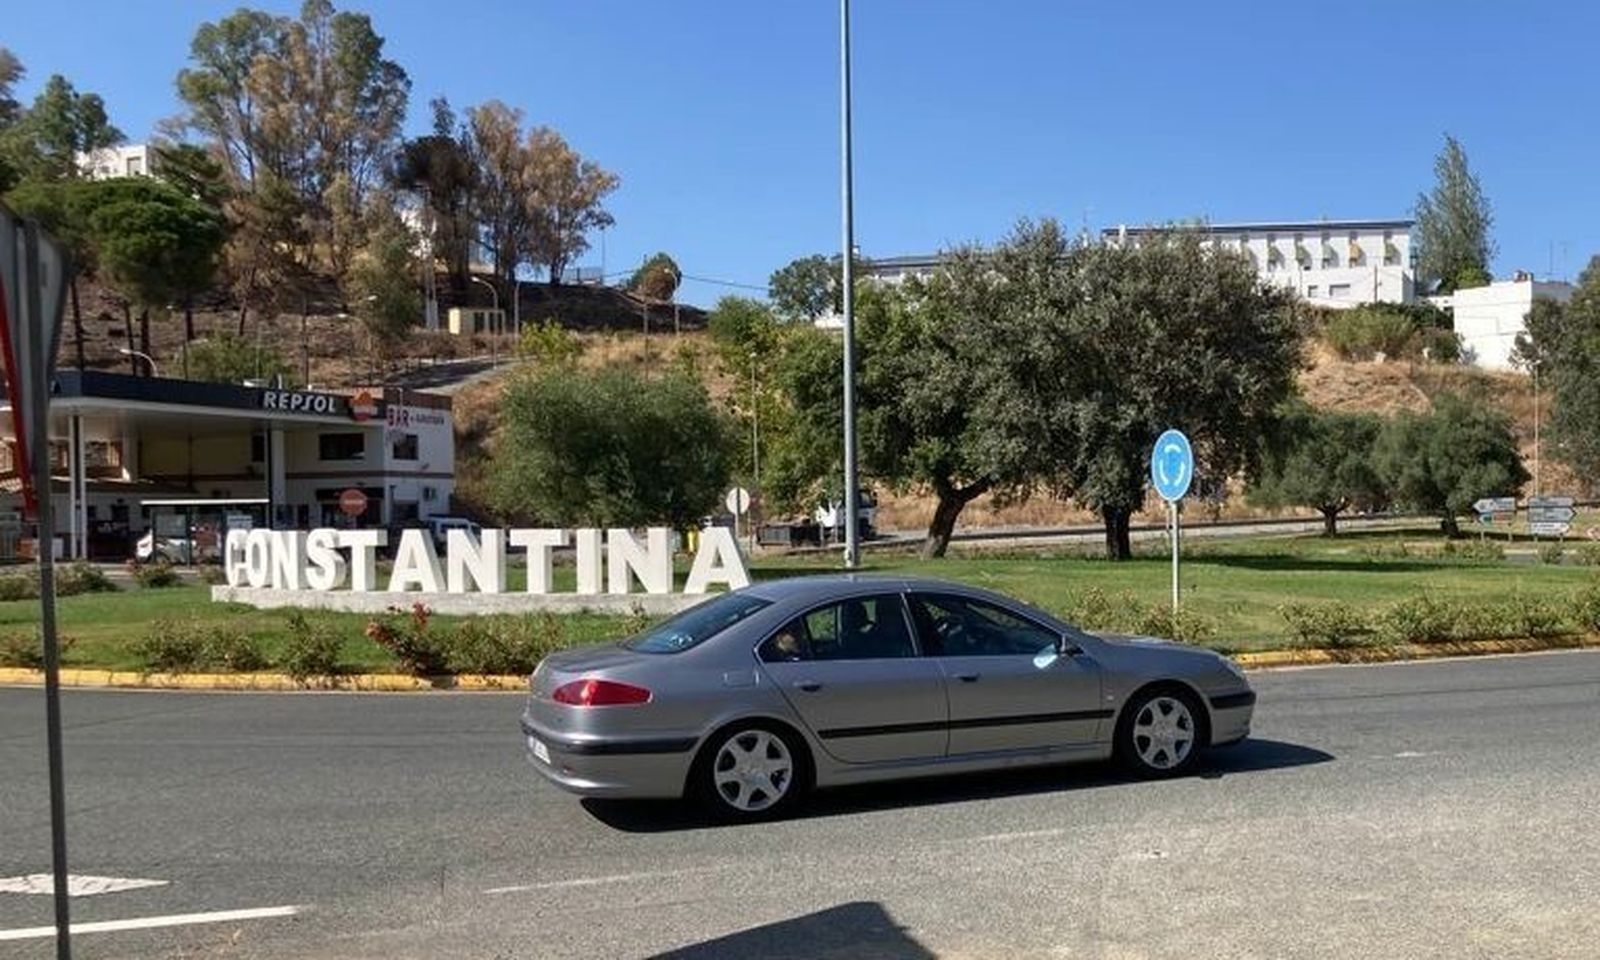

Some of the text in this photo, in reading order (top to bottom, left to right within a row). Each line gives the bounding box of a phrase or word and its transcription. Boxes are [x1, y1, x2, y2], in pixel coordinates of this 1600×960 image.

[264, 391, 336, 413] REPSOL
[387, 405, 410, 428] BAR
[225, 528, 750, 594] CONSTANTINA
